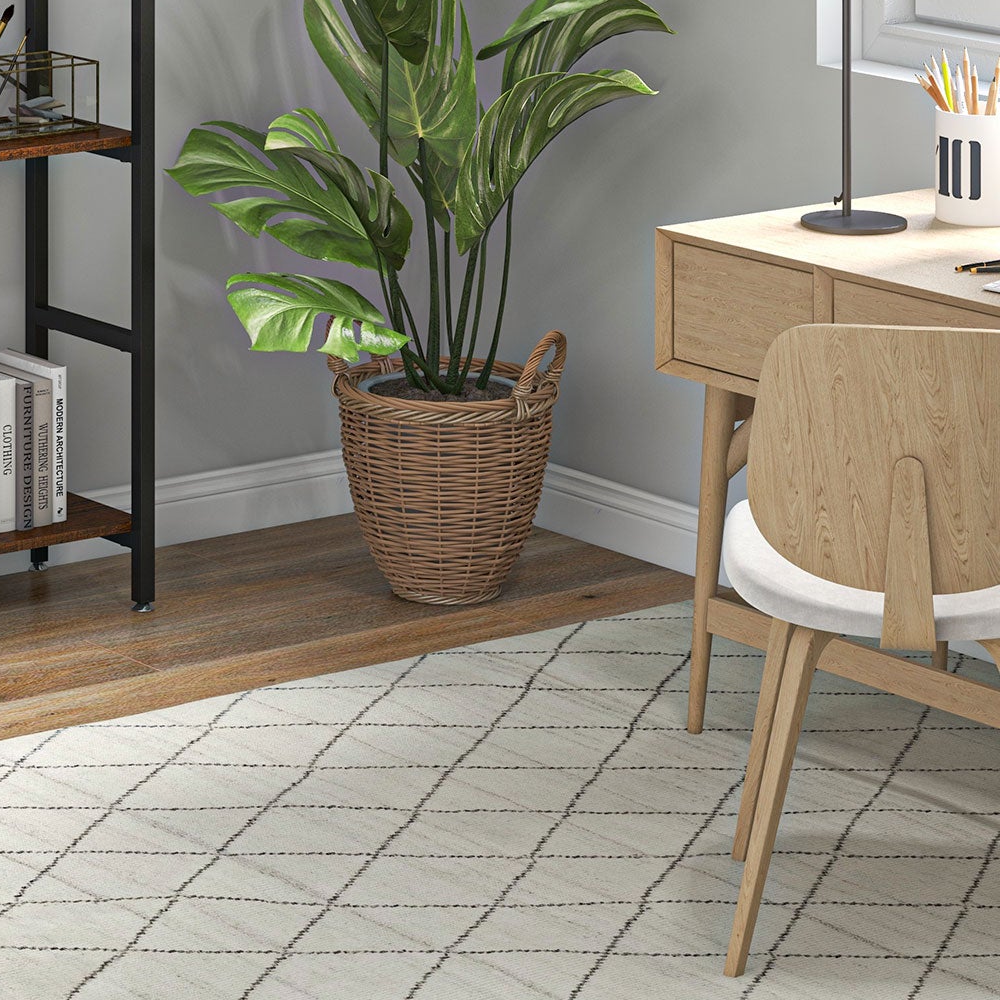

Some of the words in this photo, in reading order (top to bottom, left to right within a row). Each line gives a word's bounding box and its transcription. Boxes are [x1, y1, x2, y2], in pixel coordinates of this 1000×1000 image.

[23, 386, 32, 471] FURNITURE
[55, 398, 64, 433] MODERN
[2, 424, 13, 476] CLOTHING
[38, 422, 48, 473] WUTHERING
[55, 434, 64, 498] ARCHITECTURE
[23, 475, 32, 529] DESIGN
[38, 475, 48, 511] HEIGHTS
